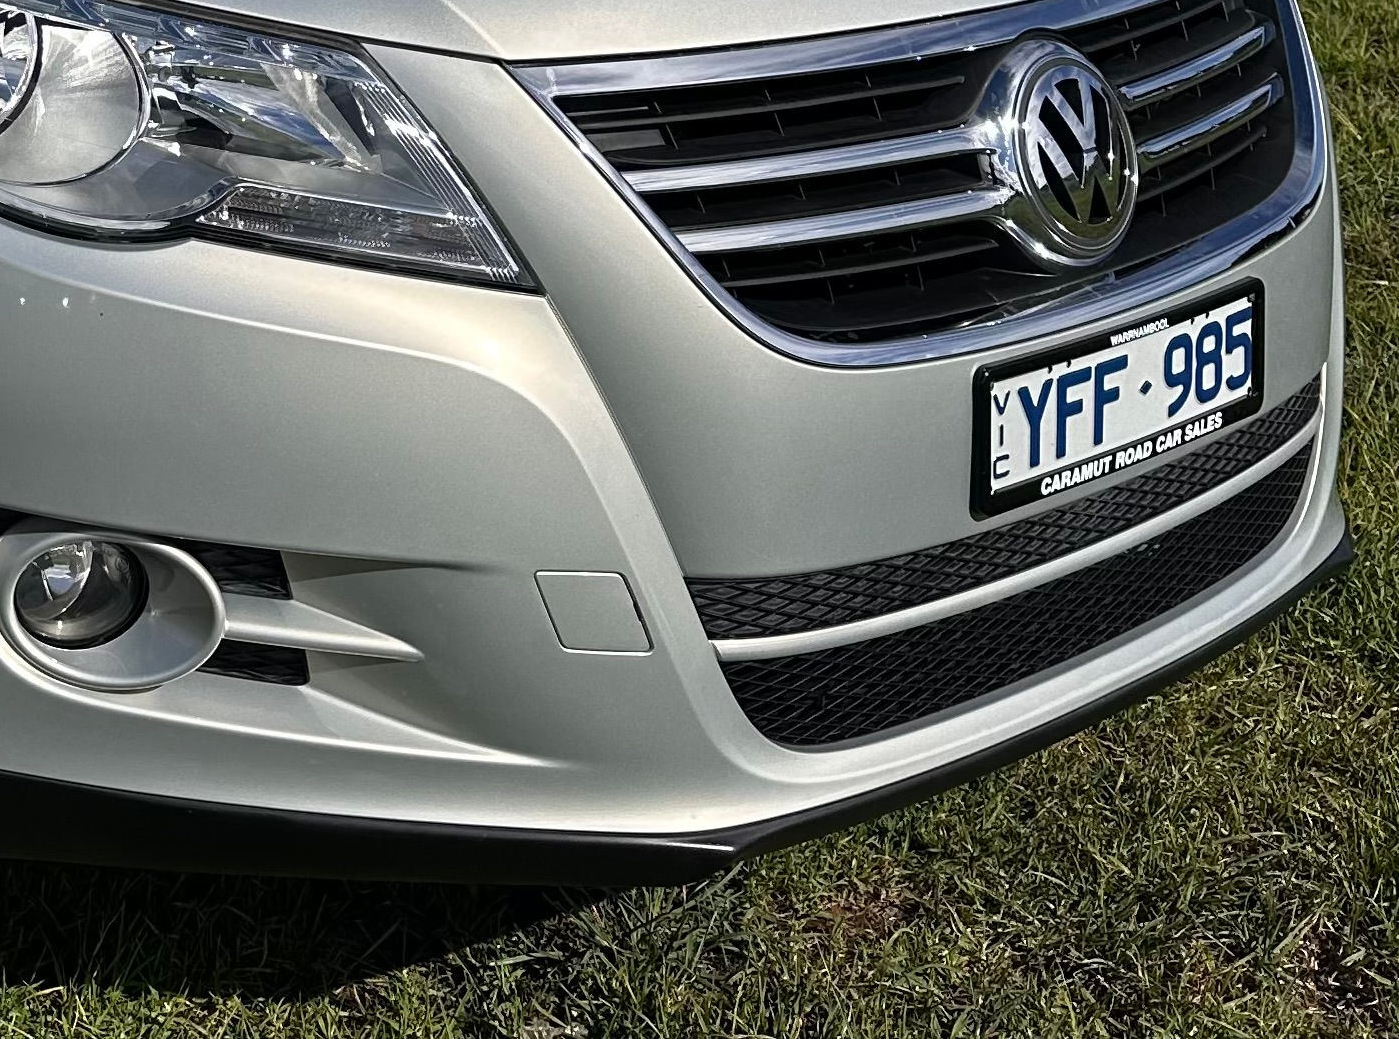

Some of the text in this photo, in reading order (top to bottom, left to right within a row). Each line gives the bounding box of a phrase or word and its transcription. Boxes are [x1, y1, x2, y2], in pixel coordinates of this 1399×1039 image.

[993, 390, 1010, 480] VIC
[1041, 411, 1223, 496] CARAMUT ROAD CAR SALES
